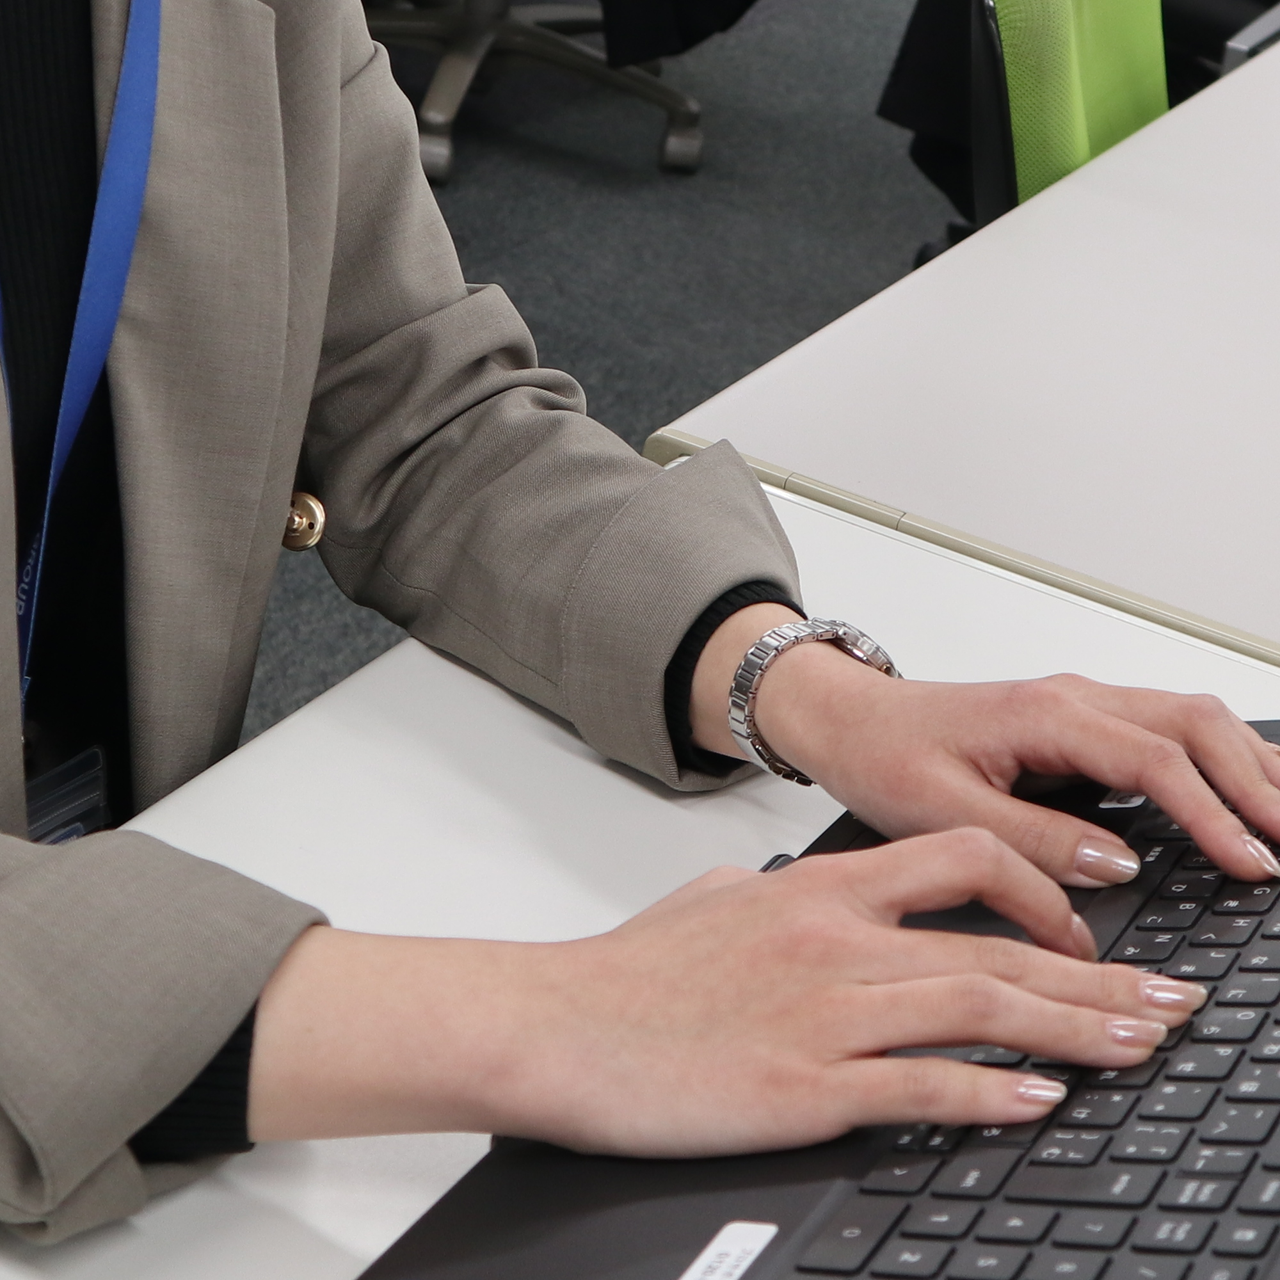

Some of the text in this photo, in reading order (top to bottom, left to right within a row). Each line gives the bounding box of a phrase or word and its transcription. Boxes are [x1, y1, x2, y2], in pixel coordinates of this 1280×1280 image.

[1236, 1010, 1256, 1020] O
[841, 1228, 862, 1239] 0
[898, 1251, 921, 1263] 2
